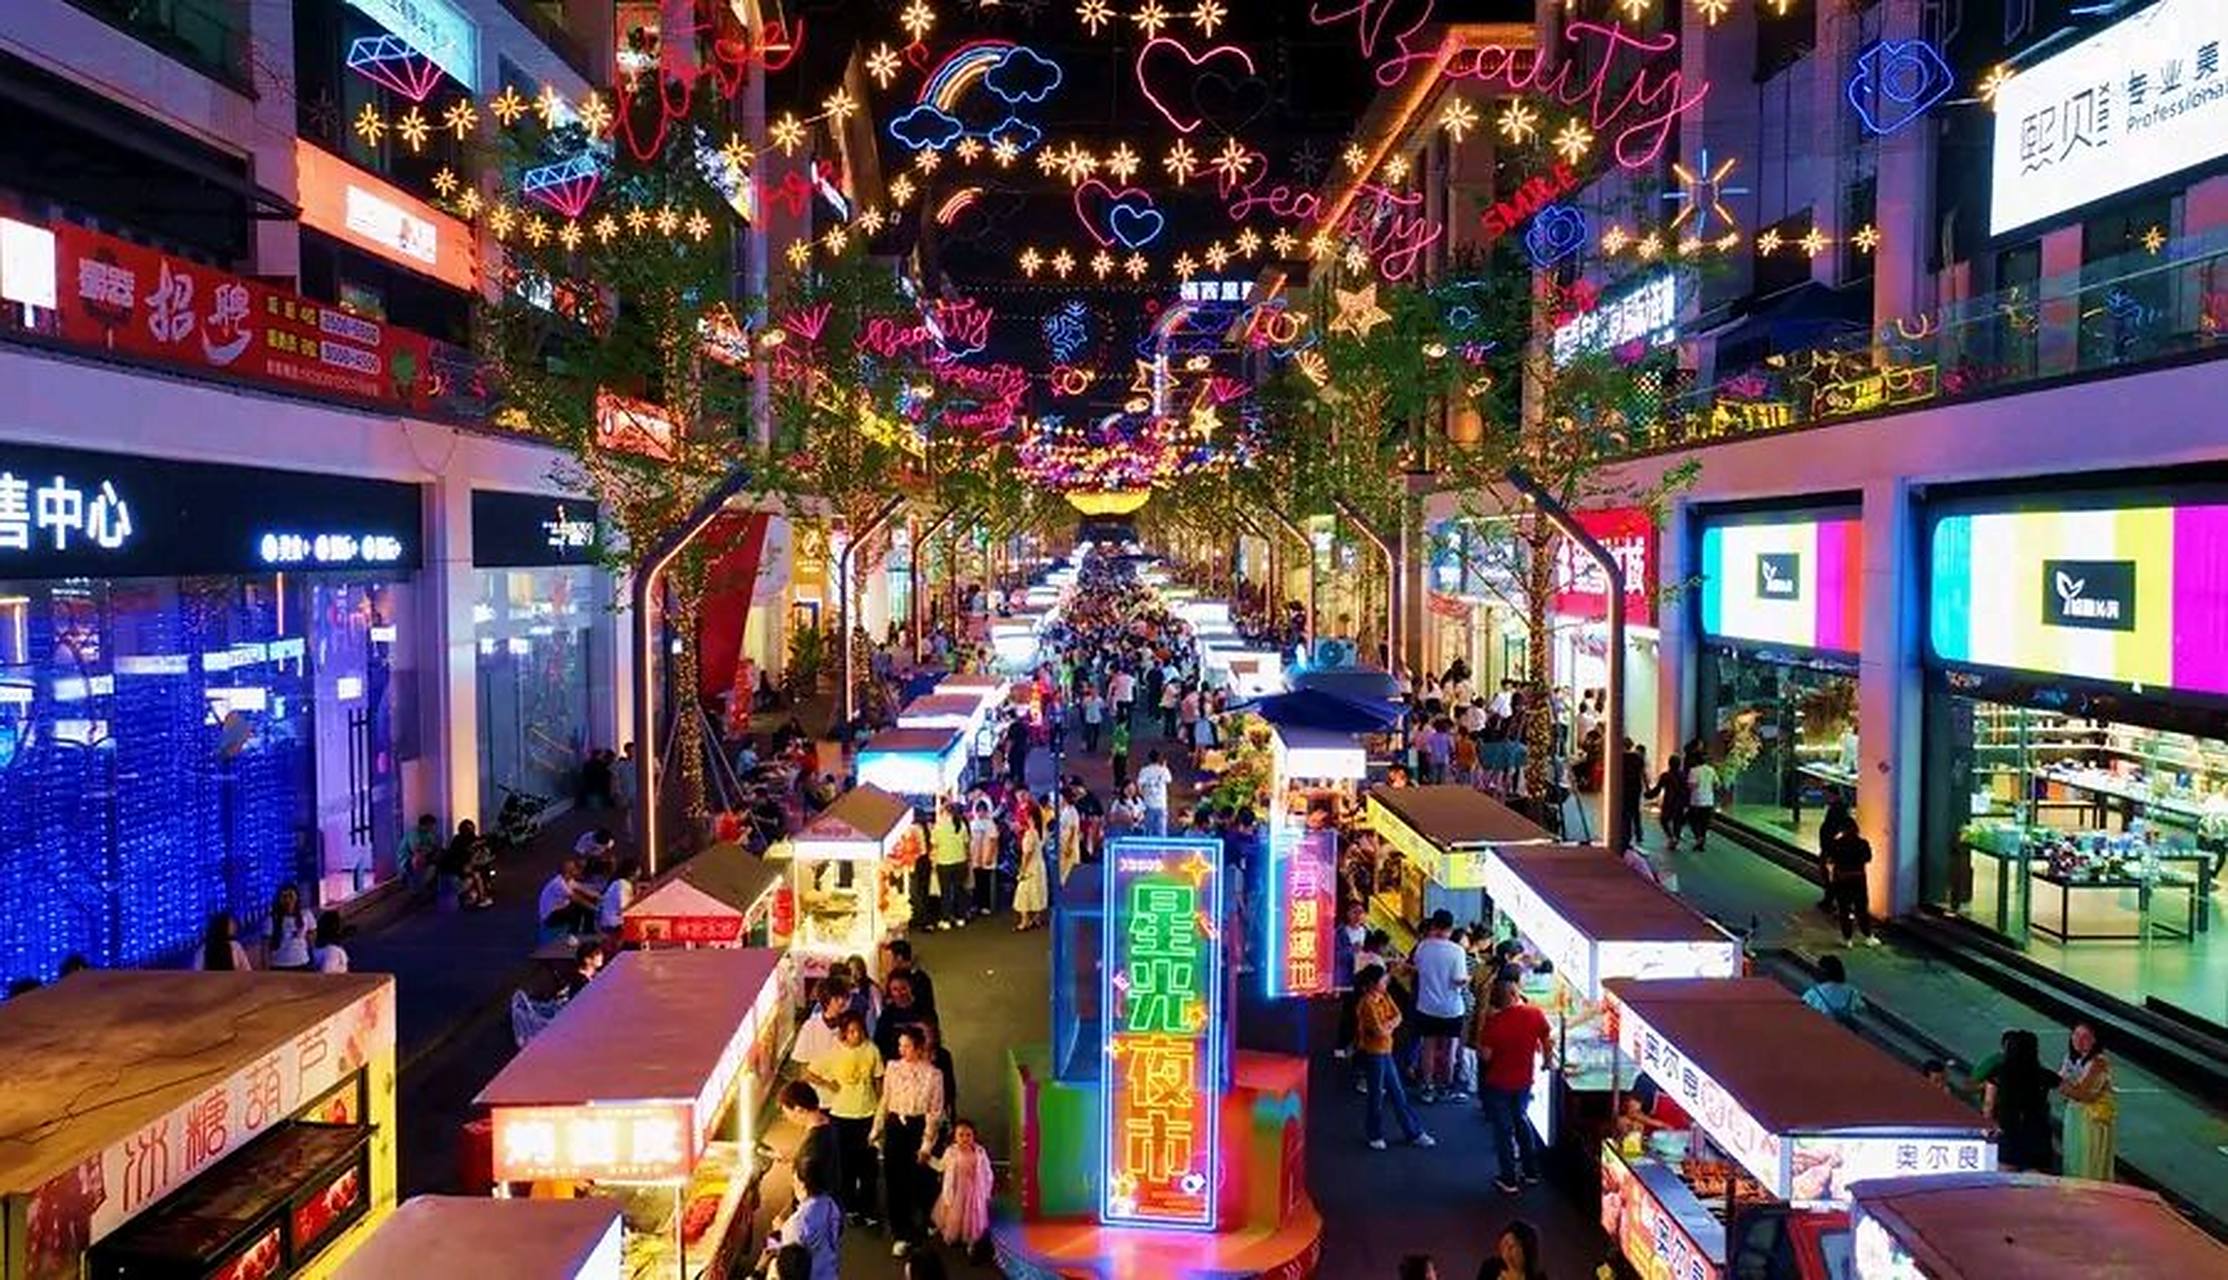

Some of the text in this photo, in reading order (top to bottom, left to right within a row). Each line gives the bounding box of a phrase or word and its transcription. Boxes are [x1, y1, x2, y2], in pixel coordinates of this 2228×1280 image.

[1310, 0, 1710, 168] Beauty
[1480, 158, 1579, 238] SMILE
[144, 256, 252, 366] 招聘
[0, 472, 132, 549] 售中心
[1128, 884, 1196, 1184] 星光夜市
[1644, 1031, 1700, 1106] 奥尔良
[123, 1026, 329, 1213] 冰糖葫芦
[1896, 1144, 1980, 1170] 奥尔良
